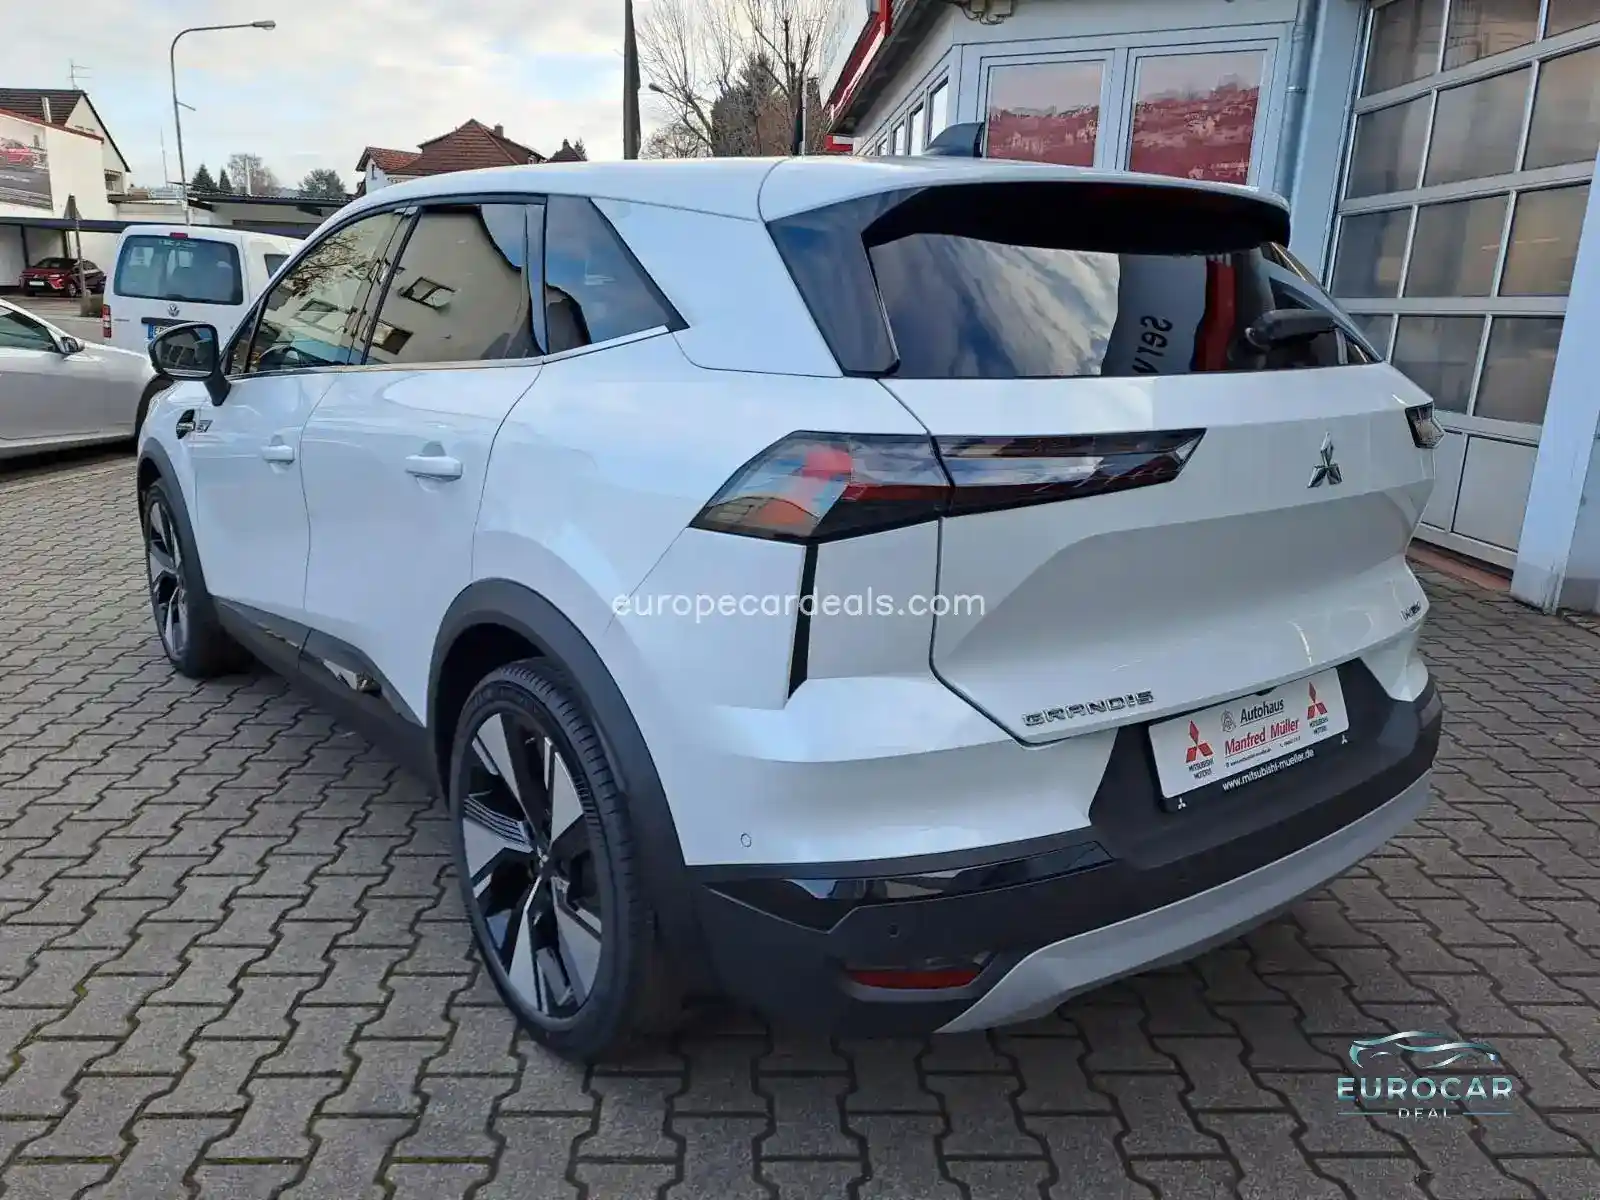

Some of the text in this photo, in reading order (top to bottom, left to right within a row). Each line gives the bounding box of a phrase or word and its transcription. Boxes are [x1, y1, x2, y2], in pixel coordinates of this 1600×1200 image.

[1022, 689, 1153, 726] GRANDIS
[1240, 699, 1284, 723] Autohaus
[1225, 728, 1266, 755] Manfred
[1270, 718, 1300, 739] Müller
[1222, 748, 1315, 791] www.mitsubishi-mueller.de
